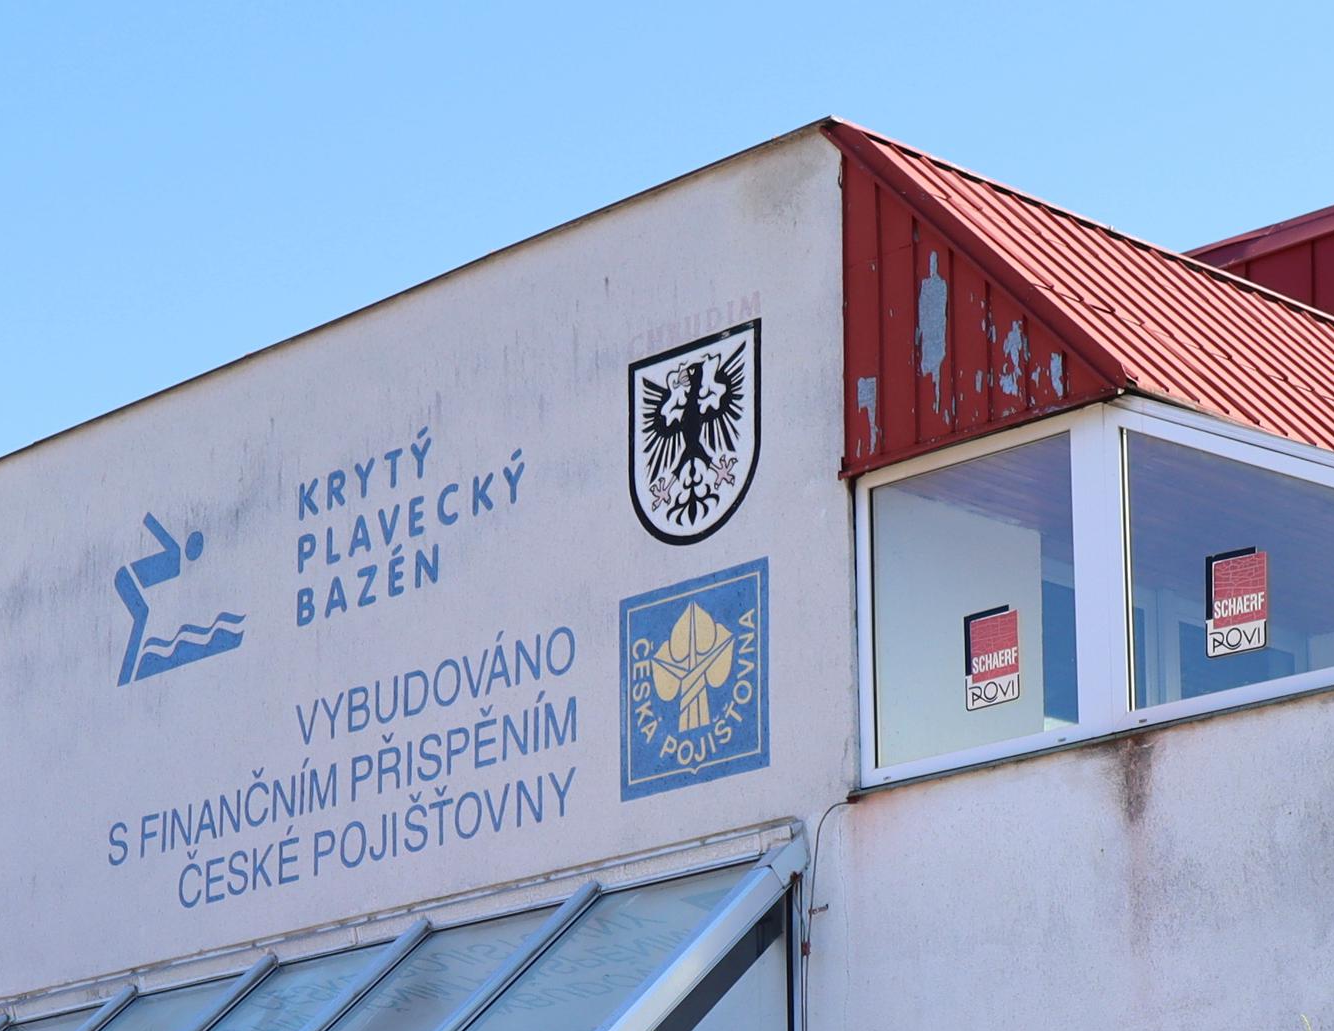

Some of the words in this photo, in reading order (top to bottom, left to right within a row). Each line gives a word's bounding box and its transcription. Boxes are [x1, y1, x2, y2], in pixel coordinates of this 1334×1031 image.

[297, 448, 525, 574] PLAVECKÝ
[298, 426, 432, 521] KRYTÝ
[297, 543, 440, 627] BAZÉN
[1214, 592, 1265, 619] SCHAERF
[296, 626, 577, 746] VYBUDOVÁNO
[632, 638, 662, 744] ČESKÁ
[659, 608, 756, 765] POJIŠŤOVNA
[972, 646, 1018, 675] SCHAERF
[1209, 627, 1261, 653] ROVI
[968, 680, 1015, 706] ROVI
[107, 820, 129, 867] S
[139, 761, 338, 858] FINANČNÍM
[351, 696, 577, 802] PŘISPĚNÍM
[177, 825, 300, 909] ČESKÉ
[313, 767, 577, 876] POJIŠŤOVNY
